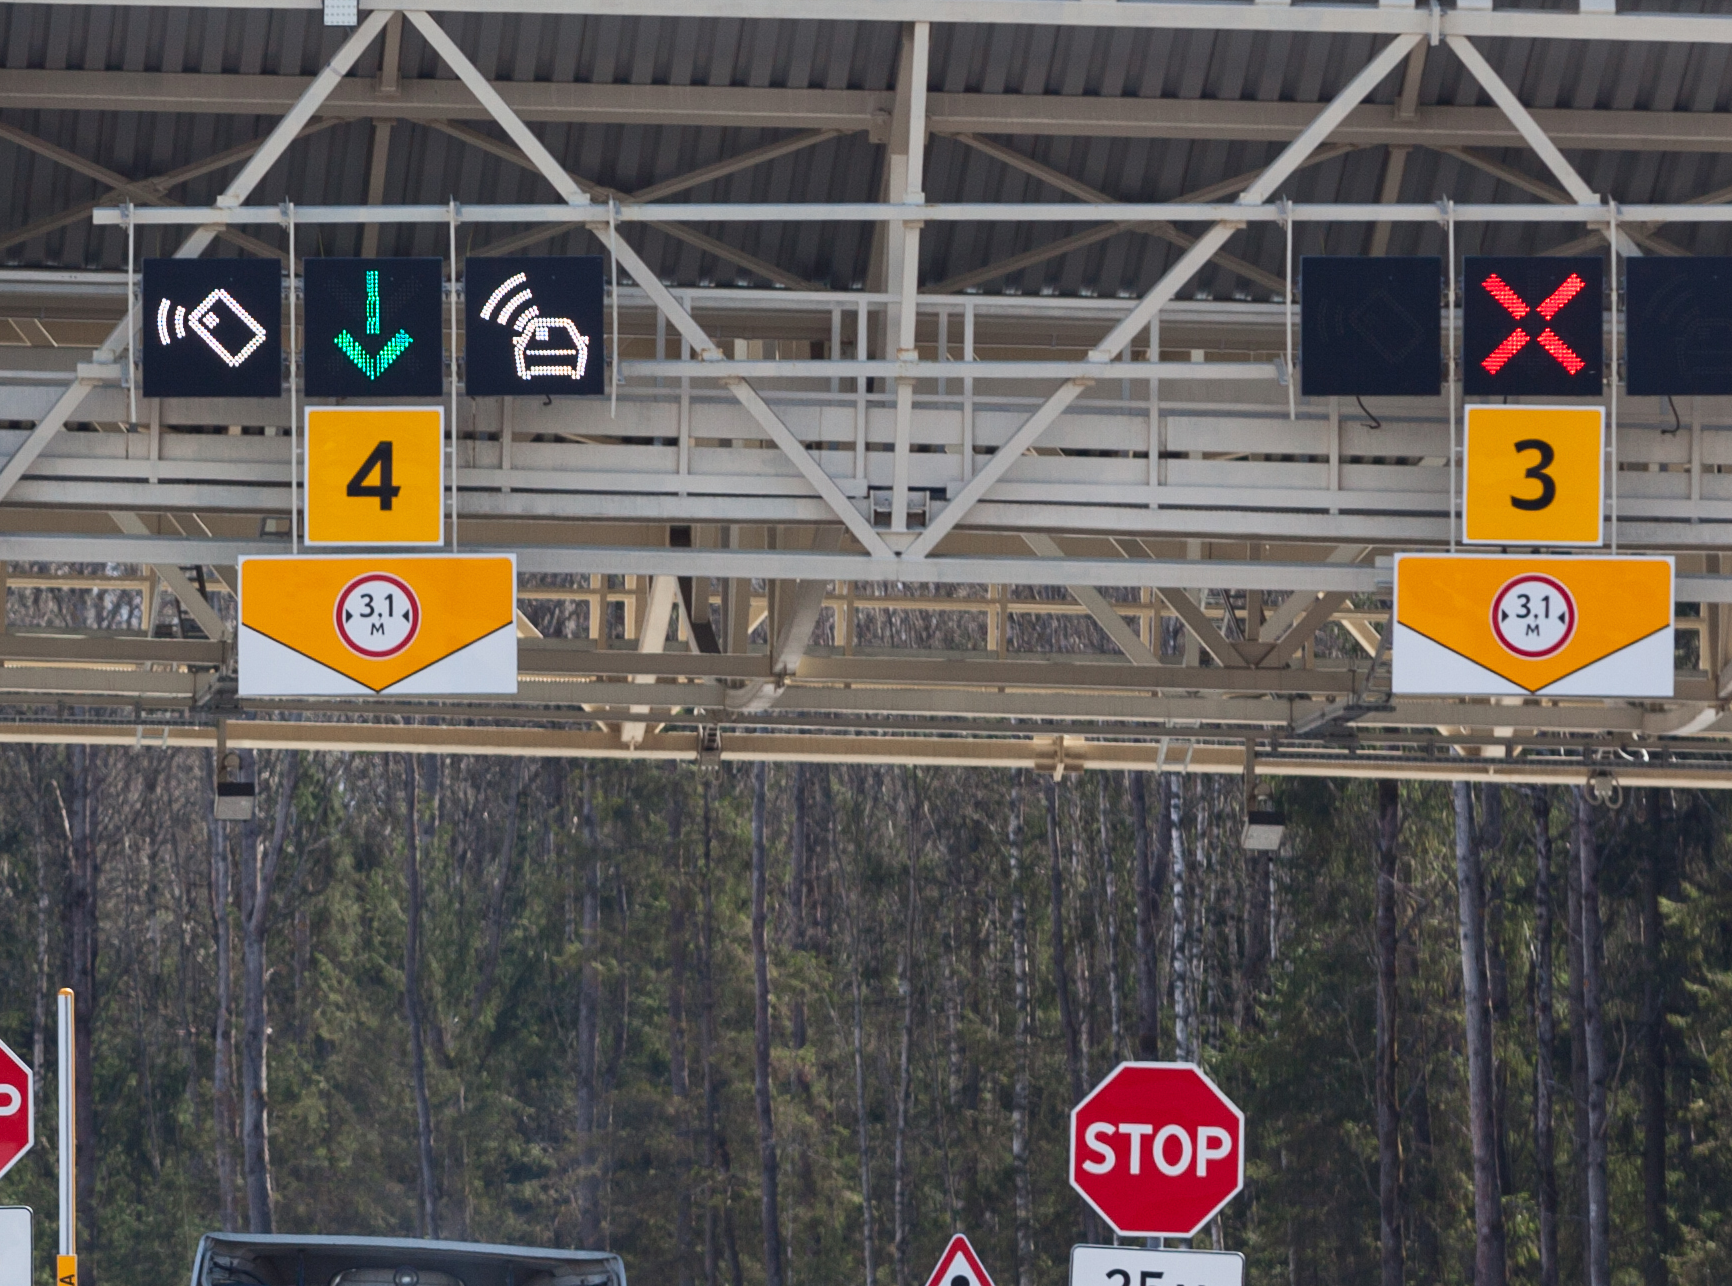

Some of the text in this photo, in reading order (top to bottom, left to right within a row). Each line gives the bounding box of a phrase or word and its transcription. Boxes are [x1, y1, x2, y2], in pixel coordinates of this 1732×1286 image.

[345, 440, 402, 512] 4
[1510, 439, 1557, 512] 3
[359, 593, 393, 621] 3,1
[1516, 594, 1550, 622] 3,1
[1082, 1121, 1234, 1177] STOP
